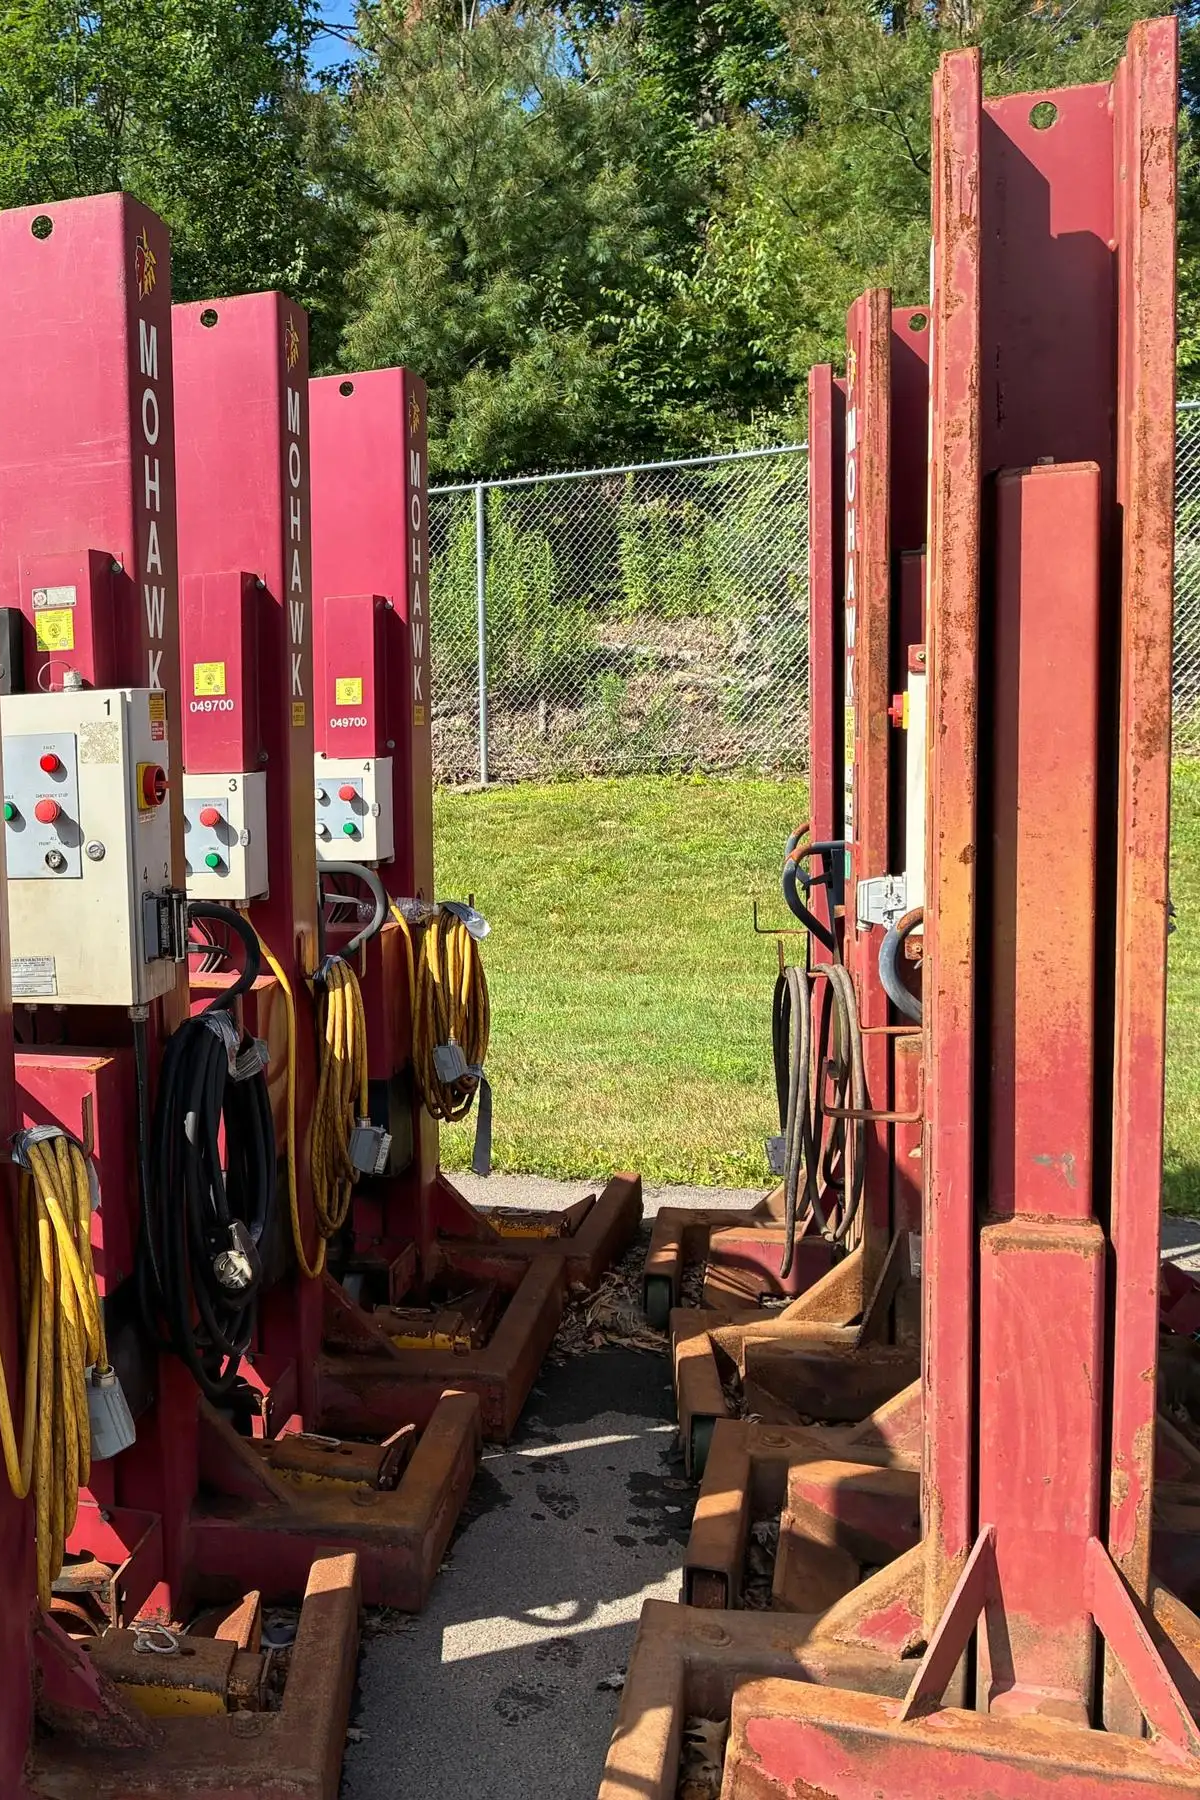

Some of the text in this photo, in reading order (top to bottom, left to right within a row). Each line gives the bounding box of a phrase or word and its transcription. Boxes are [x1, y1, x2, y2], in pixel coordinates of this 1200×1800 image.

[139, 319, 165, 688] MOHAWK
[287, 387, 303, 697] MOHAWK
[845, 407, 857, 697] MOHAWK
[410, 450, 423, 701] MOHAWK
[103, 698, 111, 715] 1
[190, 699, 234, 712] 049700
[330, 717, 367, 728] 049700
[363, 761, 371, 772] 4
[228, 778, 238, 792] 3
[143, 862, 169, 883] 4 2
